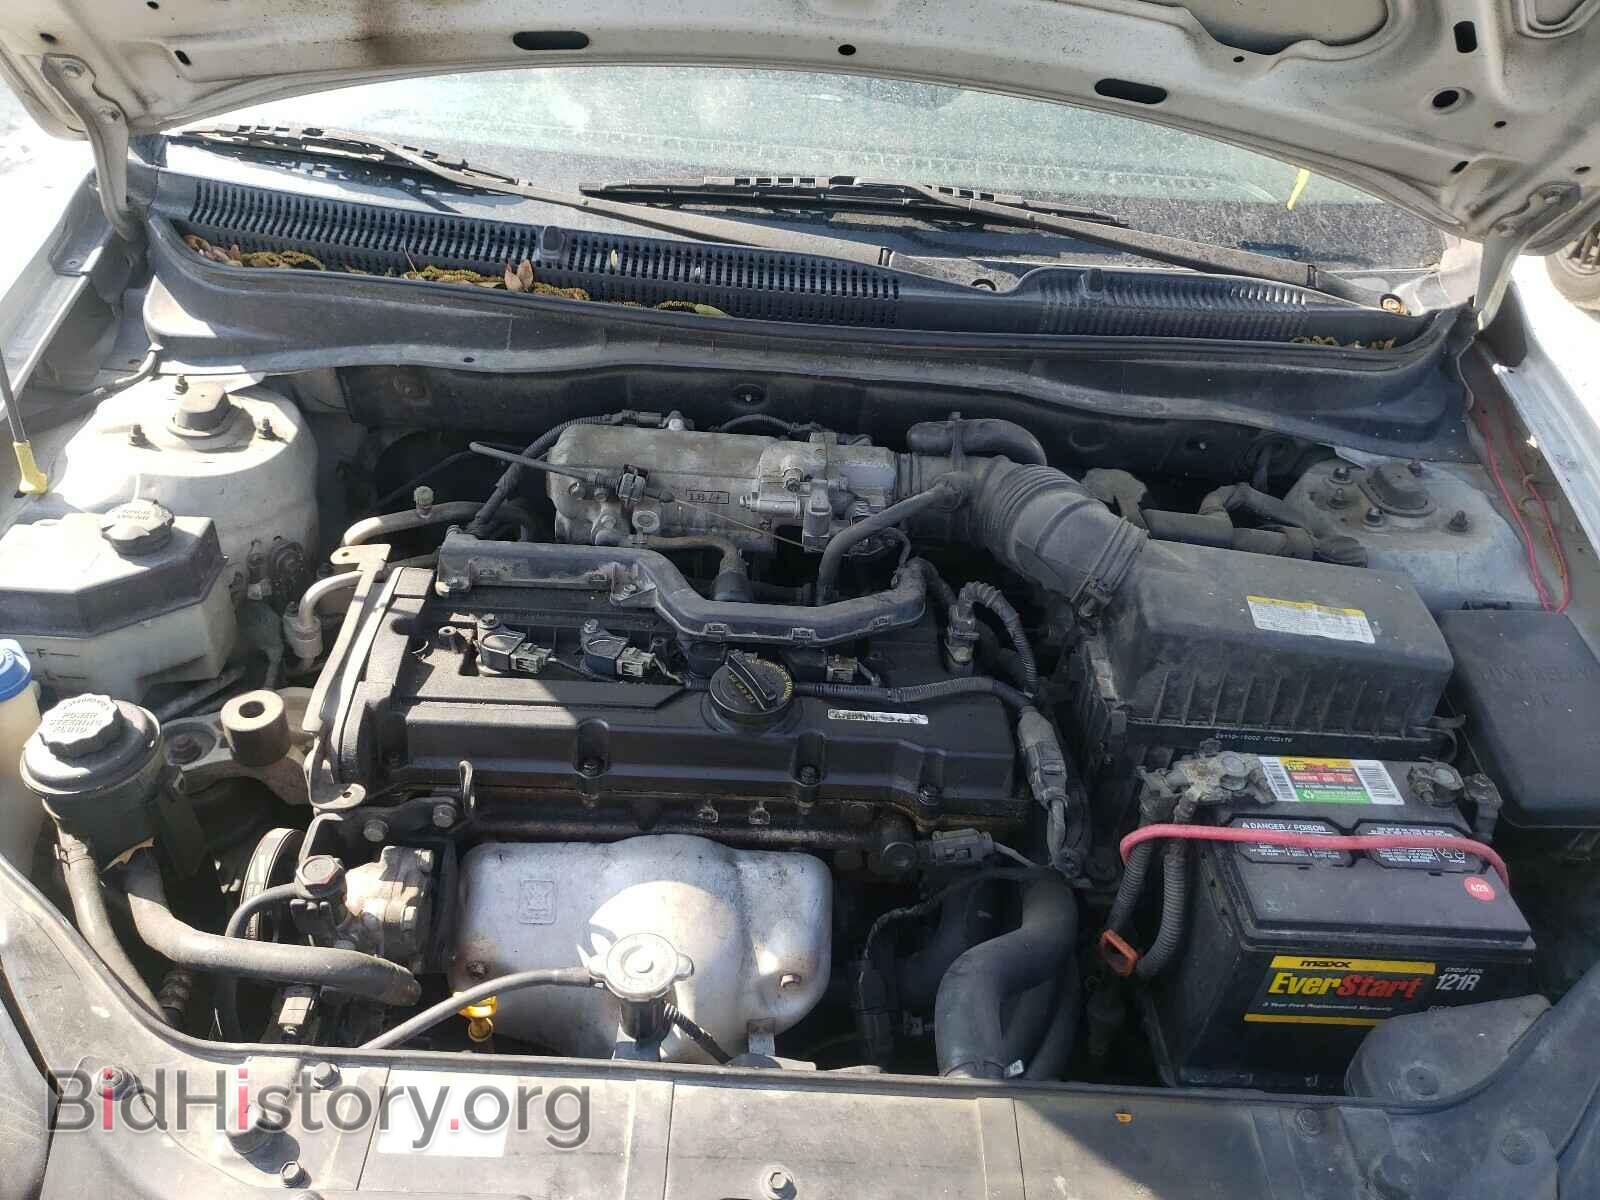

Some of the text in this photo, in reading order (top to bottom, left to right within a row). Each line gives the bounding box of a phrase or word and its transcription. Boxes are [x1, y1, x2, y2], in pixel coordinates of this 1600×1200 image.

[1249, 822, 1286, 830] DANGER
[1300, 960, 1352, 968] maxx
[1267, 971, 1424, 999] EverStart
[1435, 973, 1480, 991] 121R
